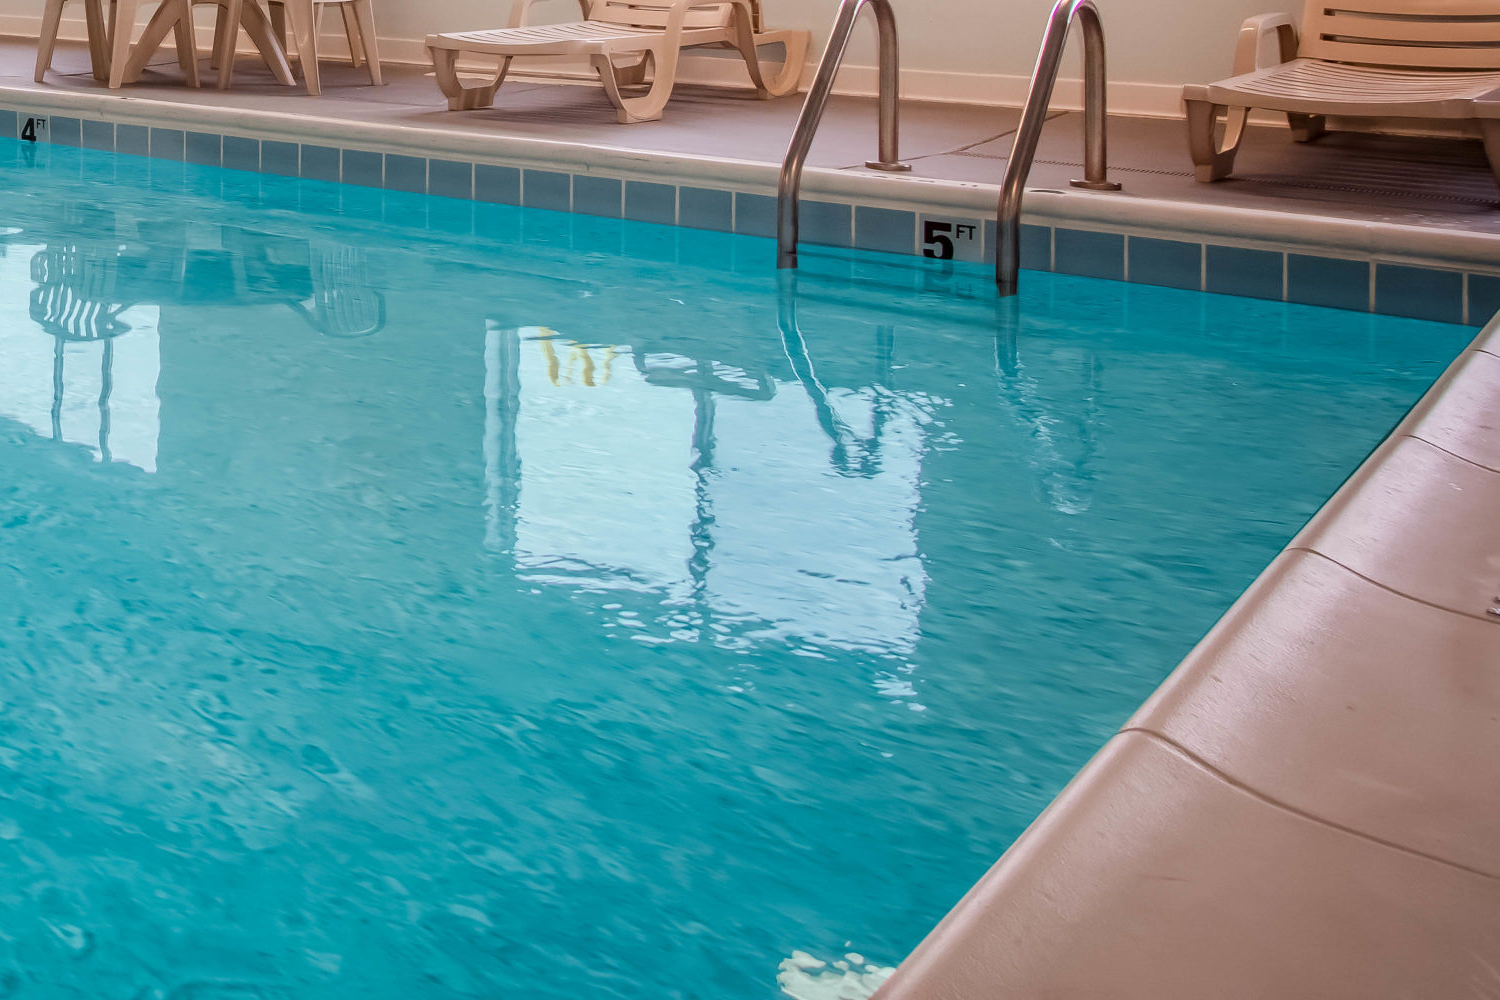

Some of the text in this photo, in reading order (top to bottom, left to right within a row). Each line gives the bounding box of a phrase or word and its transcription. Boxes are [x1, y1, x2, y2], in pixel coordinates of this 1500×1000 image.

[21, 117, 46, 142] 4 FT
[923, 220, 976, 260] 5 FT
